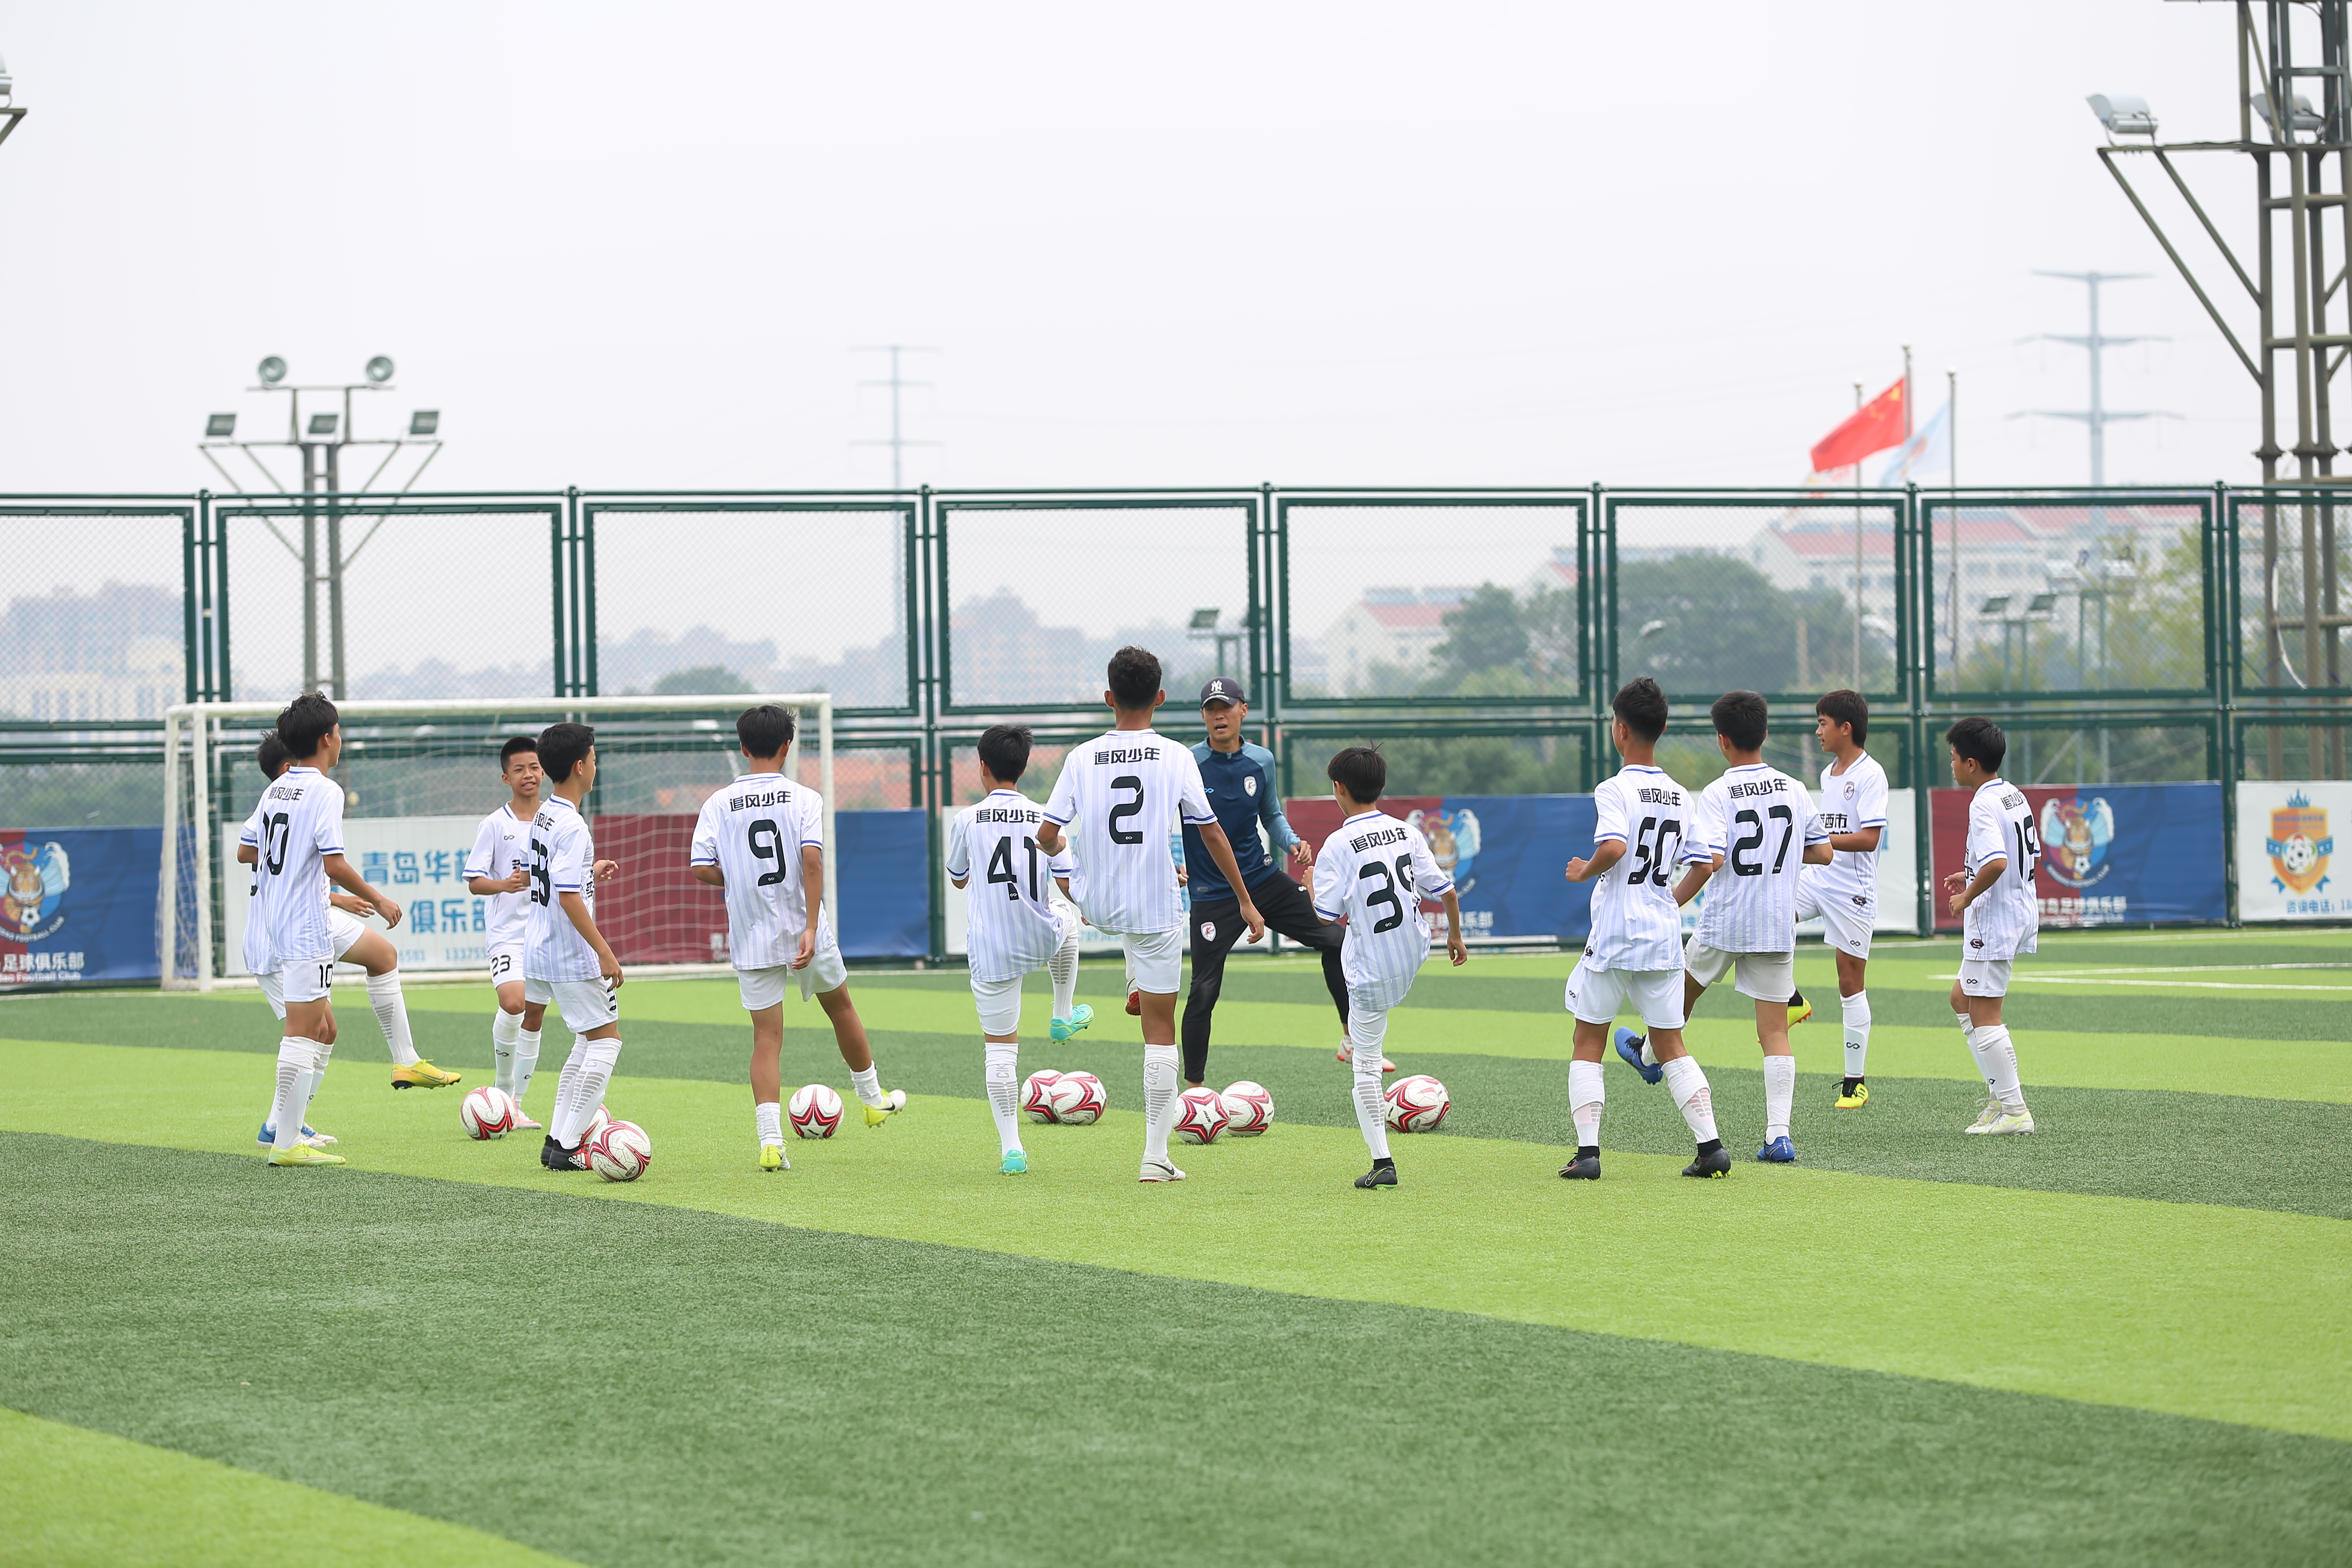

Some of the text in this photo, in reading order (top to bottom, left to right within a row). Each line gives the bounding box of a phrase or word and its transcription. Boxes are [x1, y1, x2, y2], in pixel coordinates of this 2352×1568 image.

[1095, 747, 1161, 765] 追风少年
[1637, 788, 1681, 806] 追风少年
[1728, 778, 1788, 799] 追风少年
[729, 790, 791, 812] 追风少年
[1109, 776, 1144, 844] 2
[976, 808, 1041, 824] 追风少年
[260, 811, 289, 875] 10
[748, 819, 786, 886] 9
[1350, 827, 1409, 854] 追风少年
[1627, 817, 1682, 887] 50
[1731, 805, 1792, 876] 27
[2014, 815, 2034, 881] 19
[987, 836, 1038, 902] 41
[0, 951, 84, 972] 足球俱乐部
[492, 955, 511, 977] 23
[320, 964, 333, 988] 10
[568, 1157, 587, 1170] adidas
